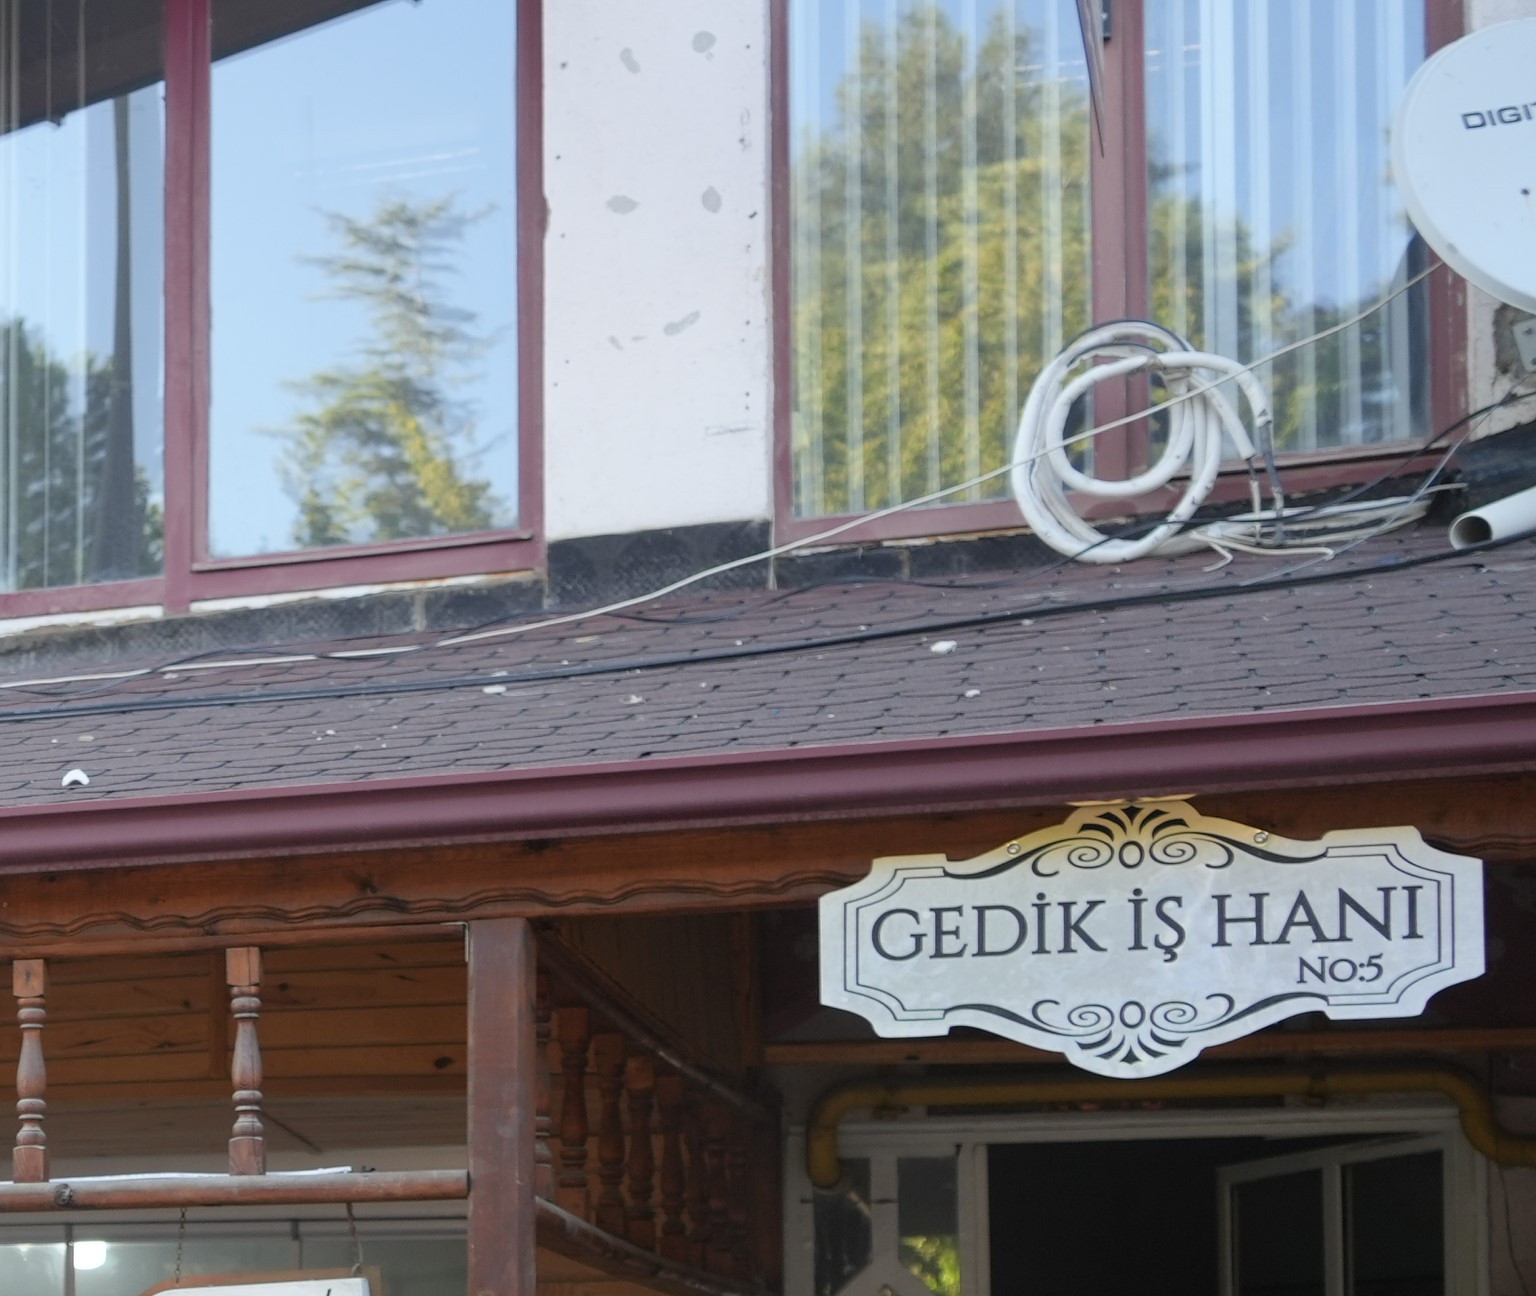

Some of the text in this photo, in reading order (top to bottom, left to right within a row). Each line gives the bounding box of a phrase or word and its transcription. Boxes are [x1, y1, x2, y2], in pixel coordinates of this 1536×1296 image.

[871, 884, 1424, 963] GEDİK İŞ HANI
